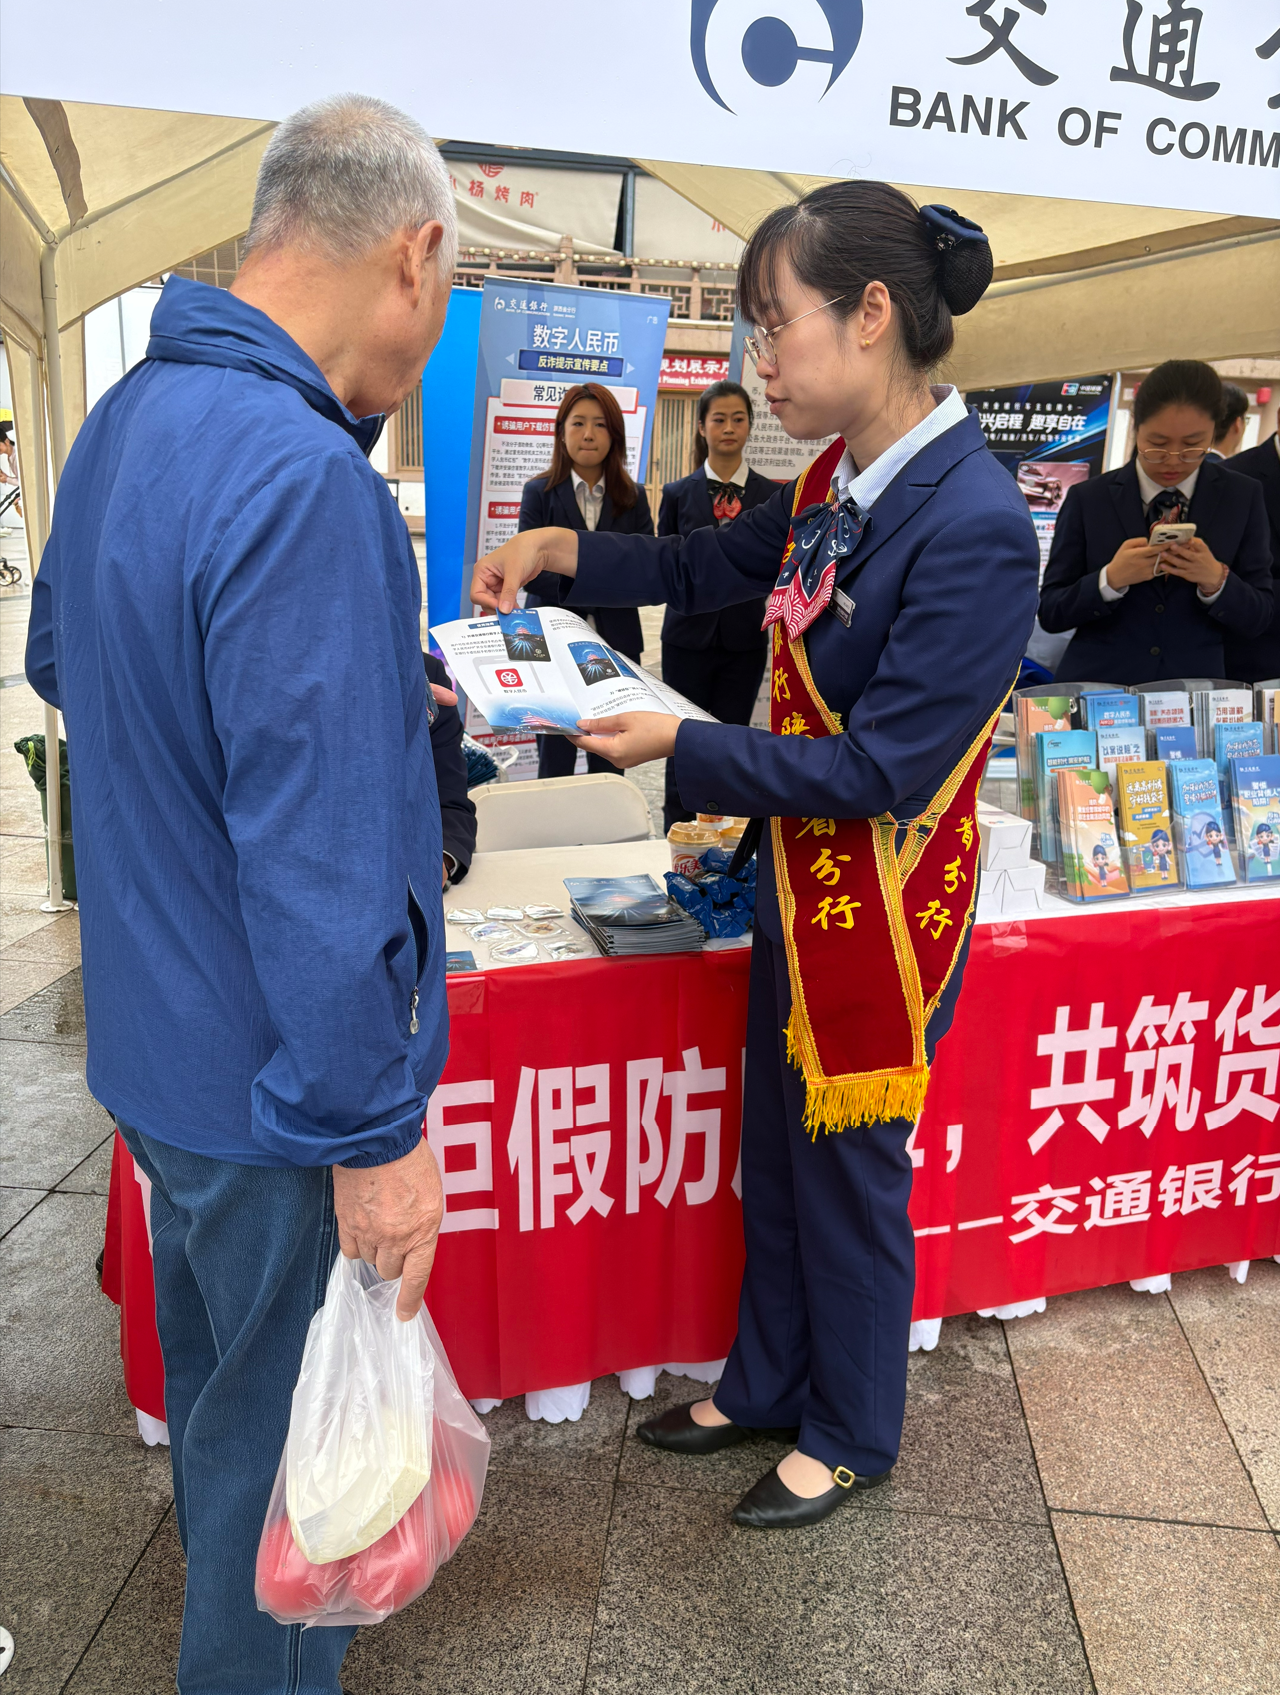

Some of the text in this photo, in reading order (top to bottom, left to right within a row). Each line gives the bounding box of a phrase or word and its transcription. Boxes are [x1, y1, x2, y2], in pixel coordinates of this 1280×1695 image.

[946, 0, 1280, 102] 交通
[889, 86, 1280, 169] BANK OF COMM
[532, 324, 620, 354] 数字人民币
[538, 355, 609, 373] 反诈提示宣传要点
[979, 412, 1087, 434] 兴启程 趣享自在
[1103, 711, 1131, 719] 数字人民币
